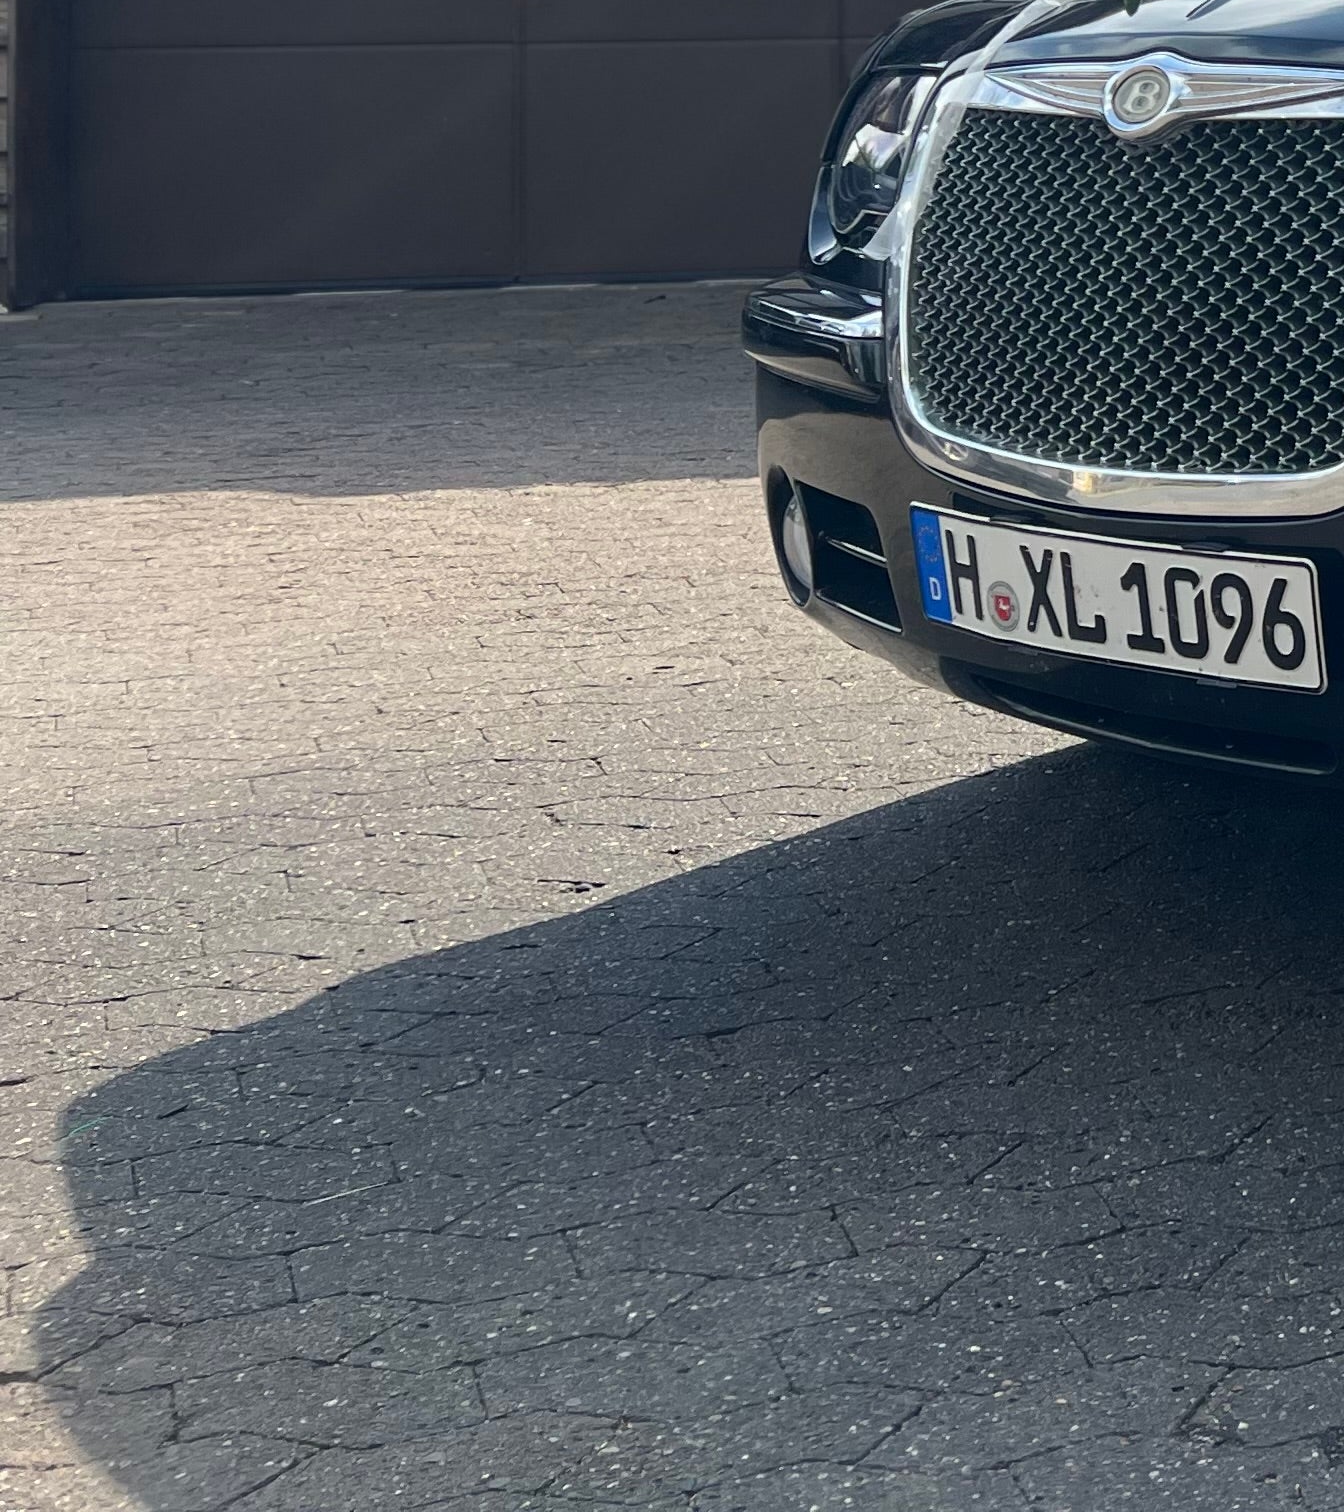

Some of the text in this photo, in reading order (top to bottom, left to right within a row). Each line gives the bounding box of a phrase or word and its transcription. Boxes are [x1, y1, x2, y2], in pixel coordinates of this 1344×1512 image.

[928, 576, 941, 601] D
[944, 528, 1306, 671] H XL 1096
